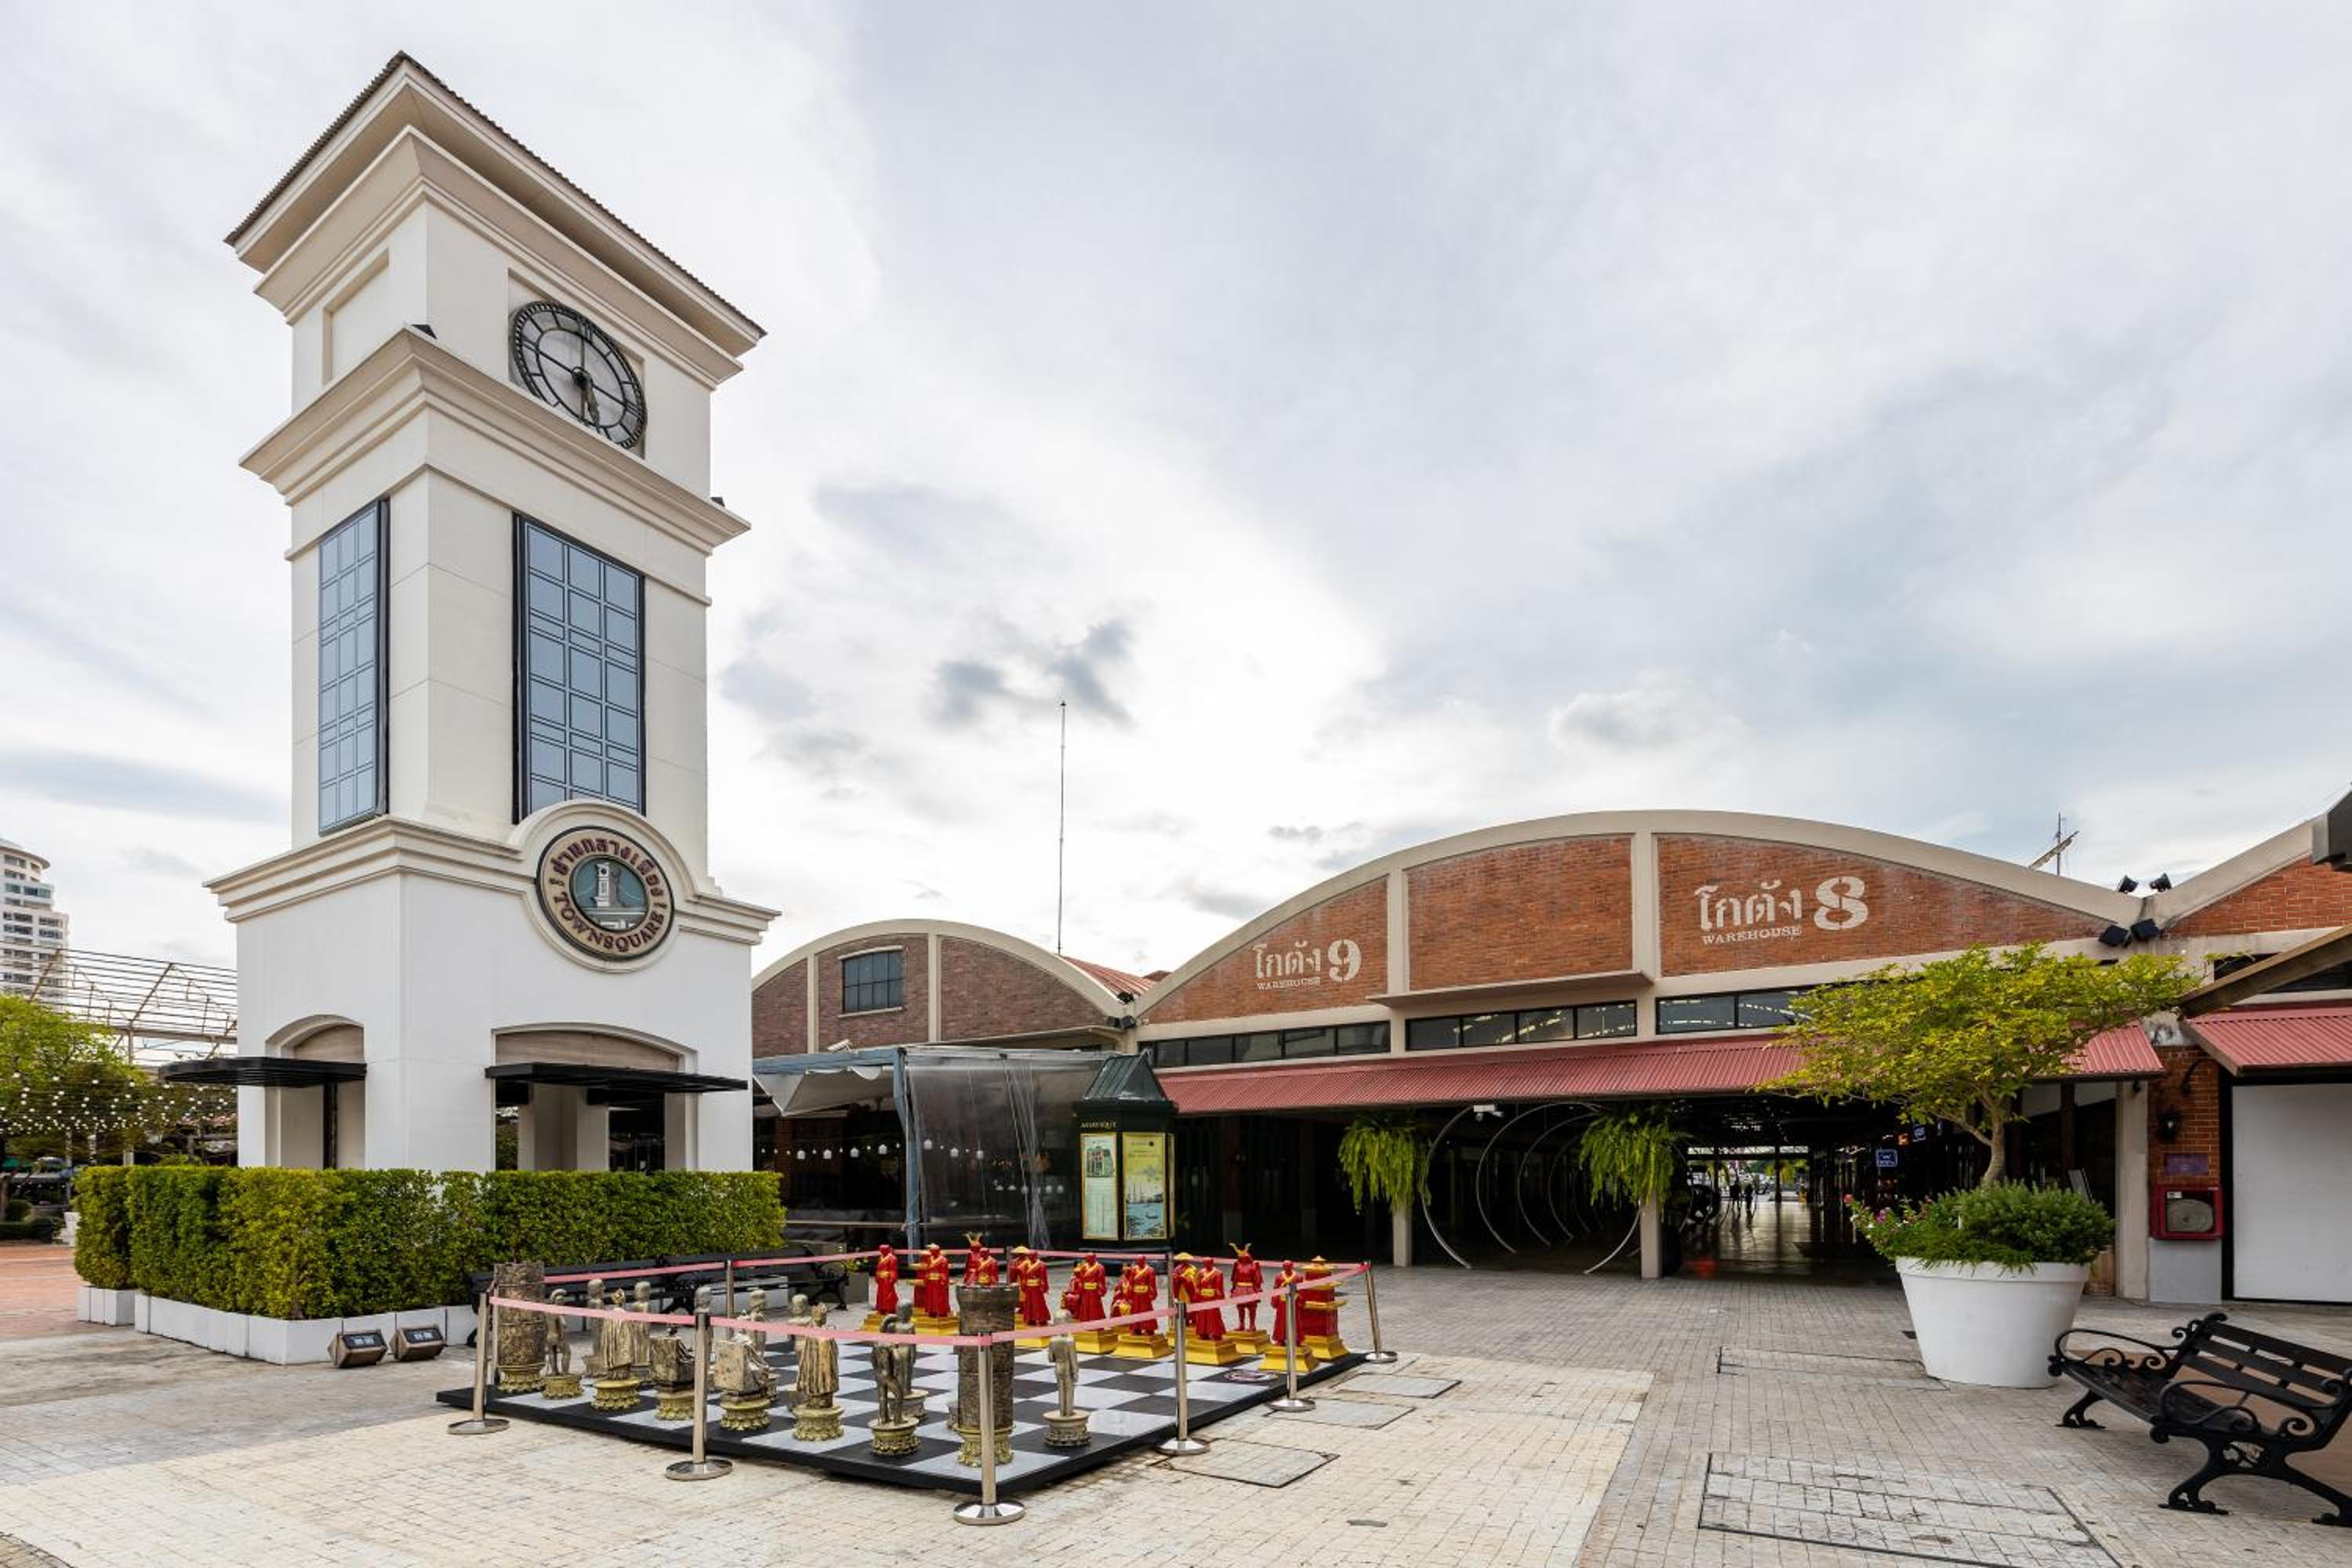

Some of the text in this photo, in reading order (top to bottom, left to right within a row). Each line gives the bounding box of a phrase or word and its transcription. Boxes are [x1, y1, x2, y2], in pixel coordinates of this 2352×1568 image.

[1694, 876, 1869, 931] โกดัง 8
[1701, 925, 1802, 945] WAREHOUSE
[1252, 938, 1362, 982] โกดัง 9
[1256, 976, 1321, 990] WAREHOUSE
